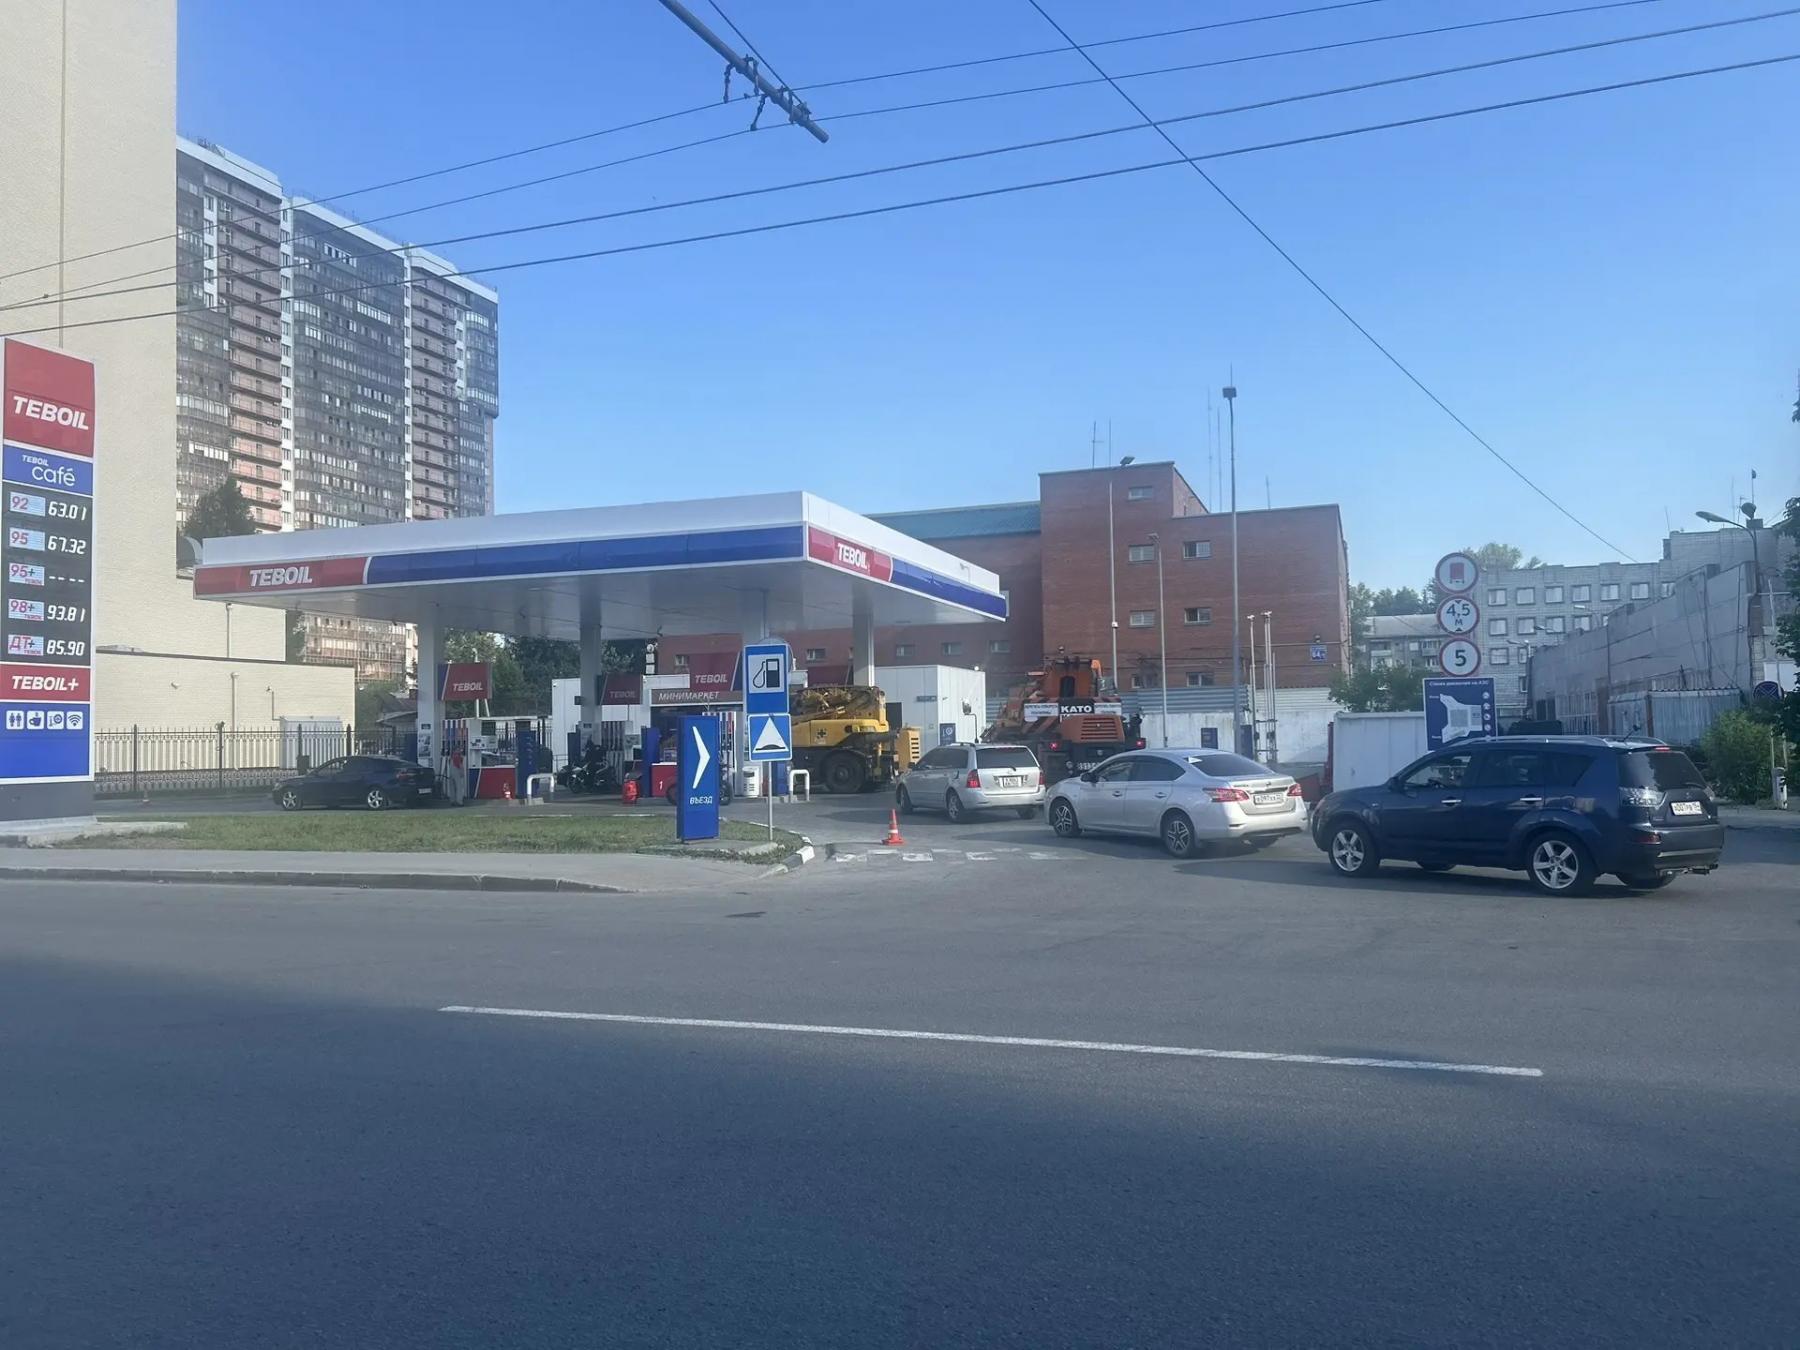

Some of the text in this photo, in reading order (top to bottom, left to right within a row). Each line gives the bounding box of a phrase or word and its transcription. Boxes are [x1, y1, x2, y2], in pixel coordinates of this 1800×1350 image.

[13, 395, 89, 430] TEBOIL
[22, 454, 49, 467] TEBOIL
[11, 496, 87, 521] 92 63.01
[11, 531, 87, 554] 95 67.32
[837, 543, 869, 570] TEBOIL
[10, 564, 36, 578] 95+
[247, 566, 313, 587] TEBOIL
[10, 600, 86, 622] 98+ 93.81
[1446, 603, 1471, 618] 4,5
[46, 640, 85, 656] 85.90
[1454, 649, 1467, 667] 5
[695, 673, 728, 684] TEBOIL
[453, 682, 484, 692] TEBOIL
[610, 690, 636, 699] TEBOIL
[658, 691, 720, 701] МИНИМАРКЕТ
[1060, 705, 1093, 713] KATO
